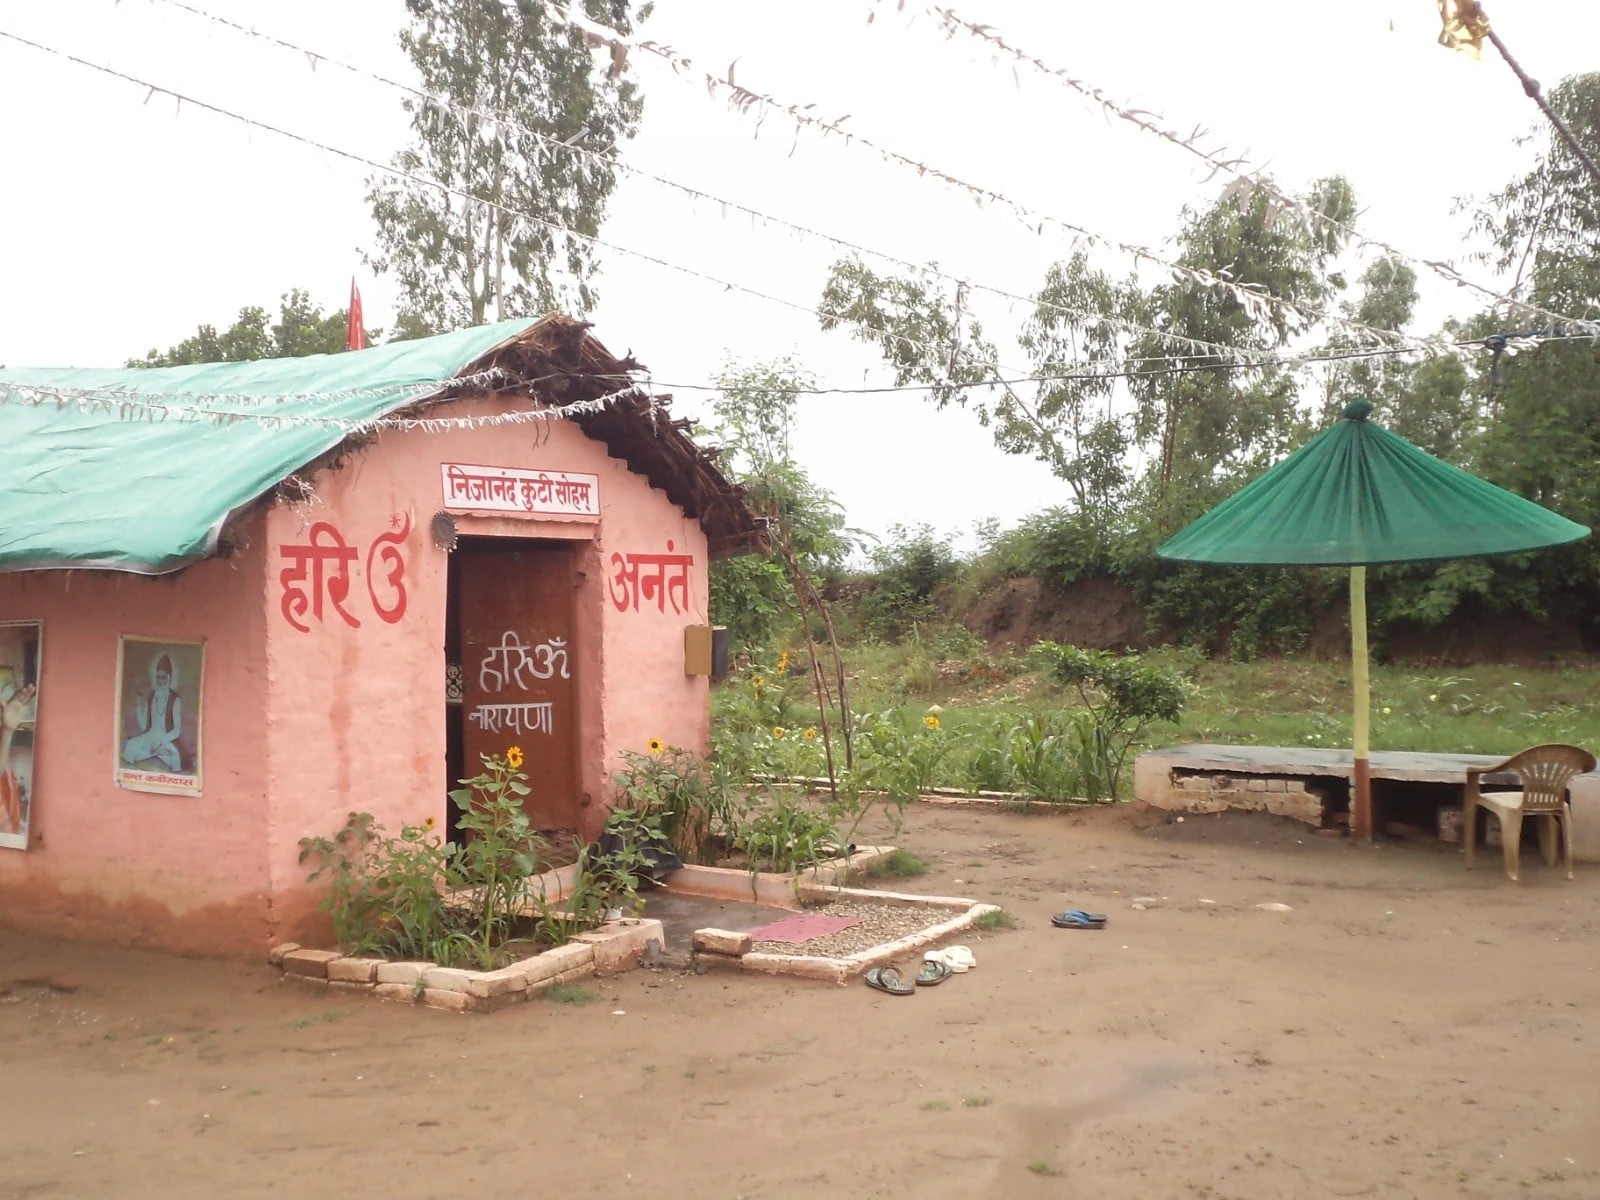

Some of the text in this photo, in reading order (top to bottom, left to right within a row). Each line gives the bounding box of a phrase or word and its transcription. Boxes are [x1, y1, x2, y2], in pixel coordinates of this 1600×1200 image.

[447, 465, 517, 506] निजानंद
[517, 473, 555, 512] कुटी
[280, 521, 361, 633] हरि
[609, 539, 694, 616] अनंत
